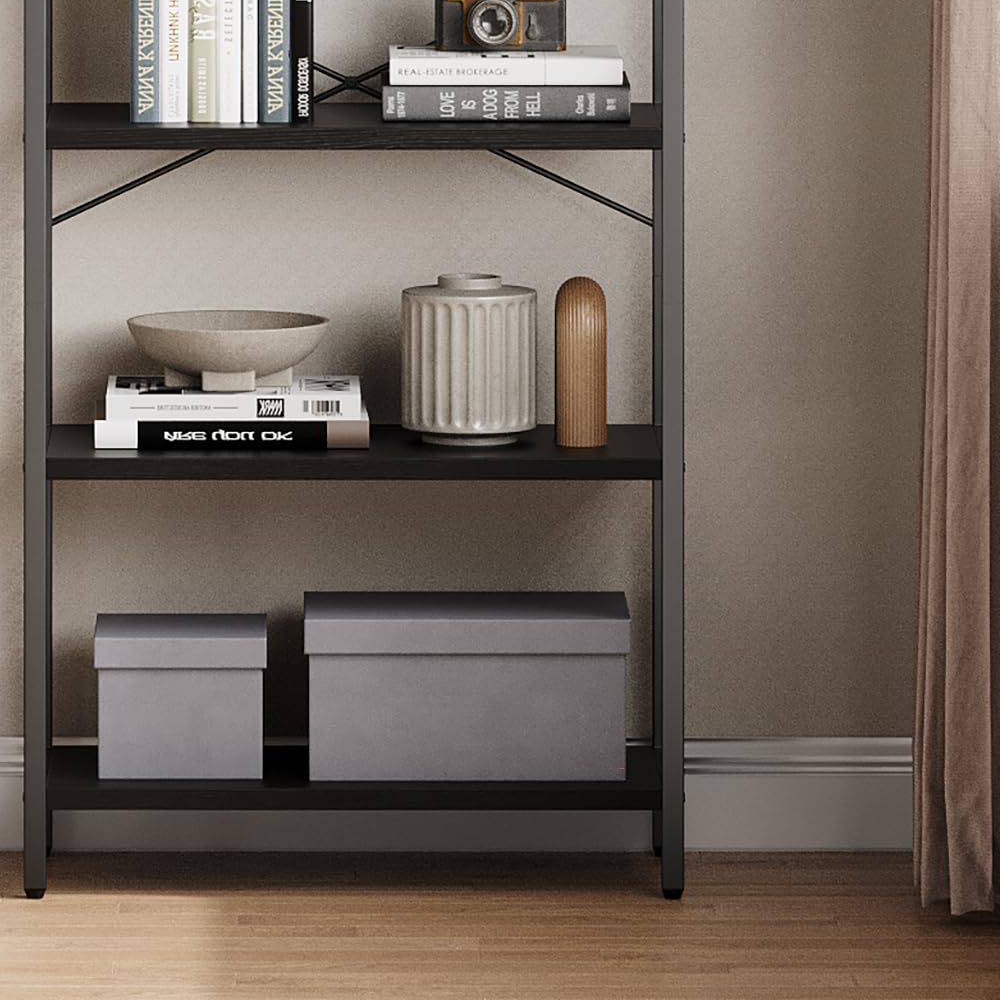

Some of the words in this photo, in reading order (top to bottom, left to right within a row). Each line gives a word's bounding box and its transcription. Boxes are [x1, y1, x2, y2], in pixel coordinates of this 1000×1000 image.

[398, 69, 453, 77] REAL-ESTATE
[456, 69, 509, 77] BROKERAGE
[440, 91, 456, 118] LOVE
[461, 99, 476, 110] IS
[483, 88, 498, 110] DOG
[504, 90, 519, 119] FROM
[526, 91, 541, 117] HELL
[483, 110, 498, 121] A
